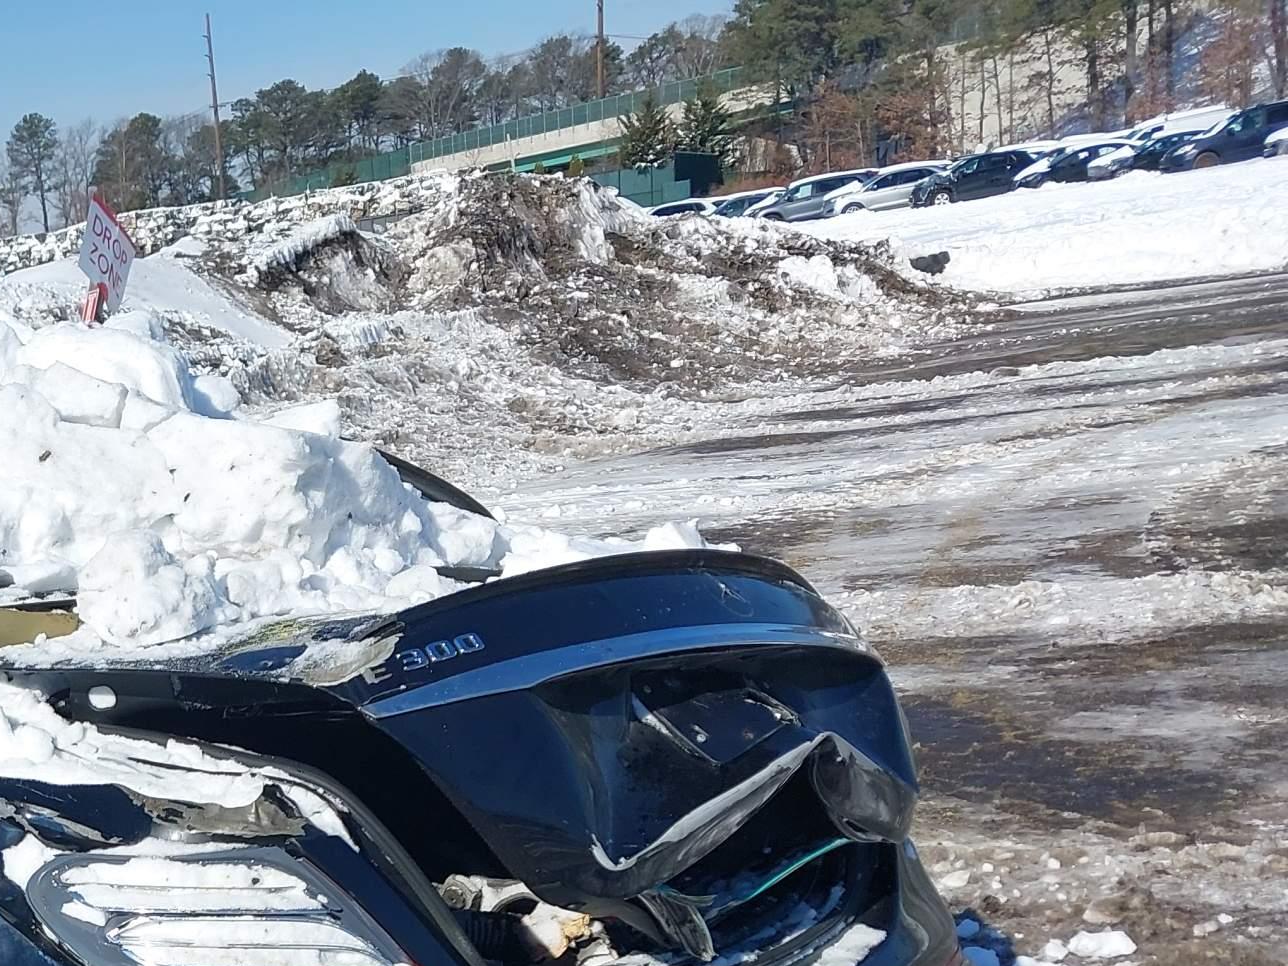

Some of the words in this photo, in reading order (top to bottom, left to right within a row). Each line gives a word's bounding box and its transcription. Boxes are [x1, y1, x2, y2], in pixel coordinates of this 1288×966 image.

[92, 213, 128, 266] DROP
[89, 242, 123, 298] ZONE
[396, 632, 486, 672] 300
